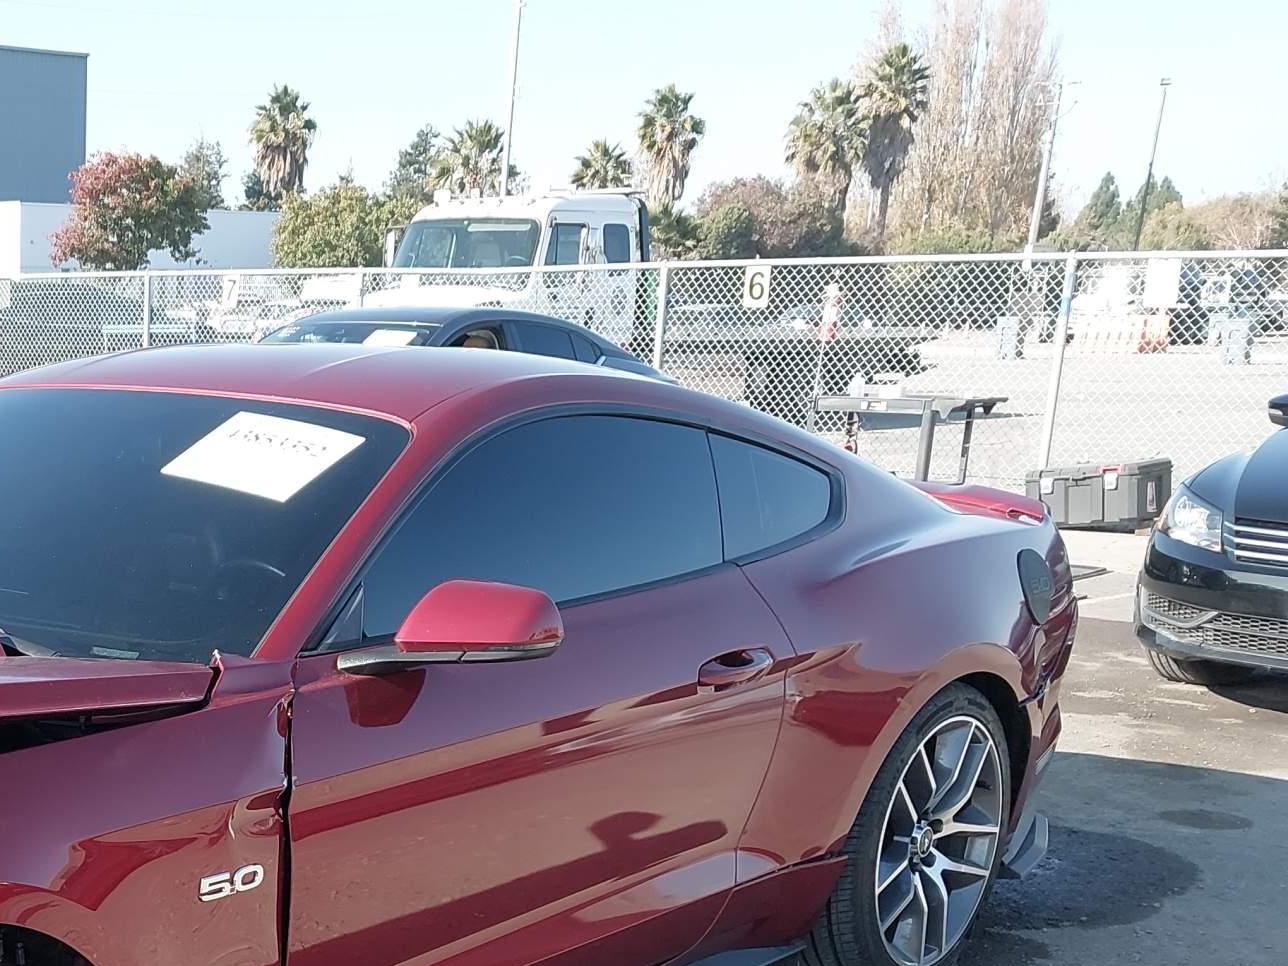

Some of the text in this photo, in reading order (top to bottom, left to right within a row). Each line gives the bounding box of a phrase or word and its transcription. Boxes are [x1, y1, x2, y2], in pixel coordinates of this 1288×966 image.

[227, 279, 237, 300] 7
[749, 271, 765, 300] 6
[198, 863, 264, 903] 5.0
